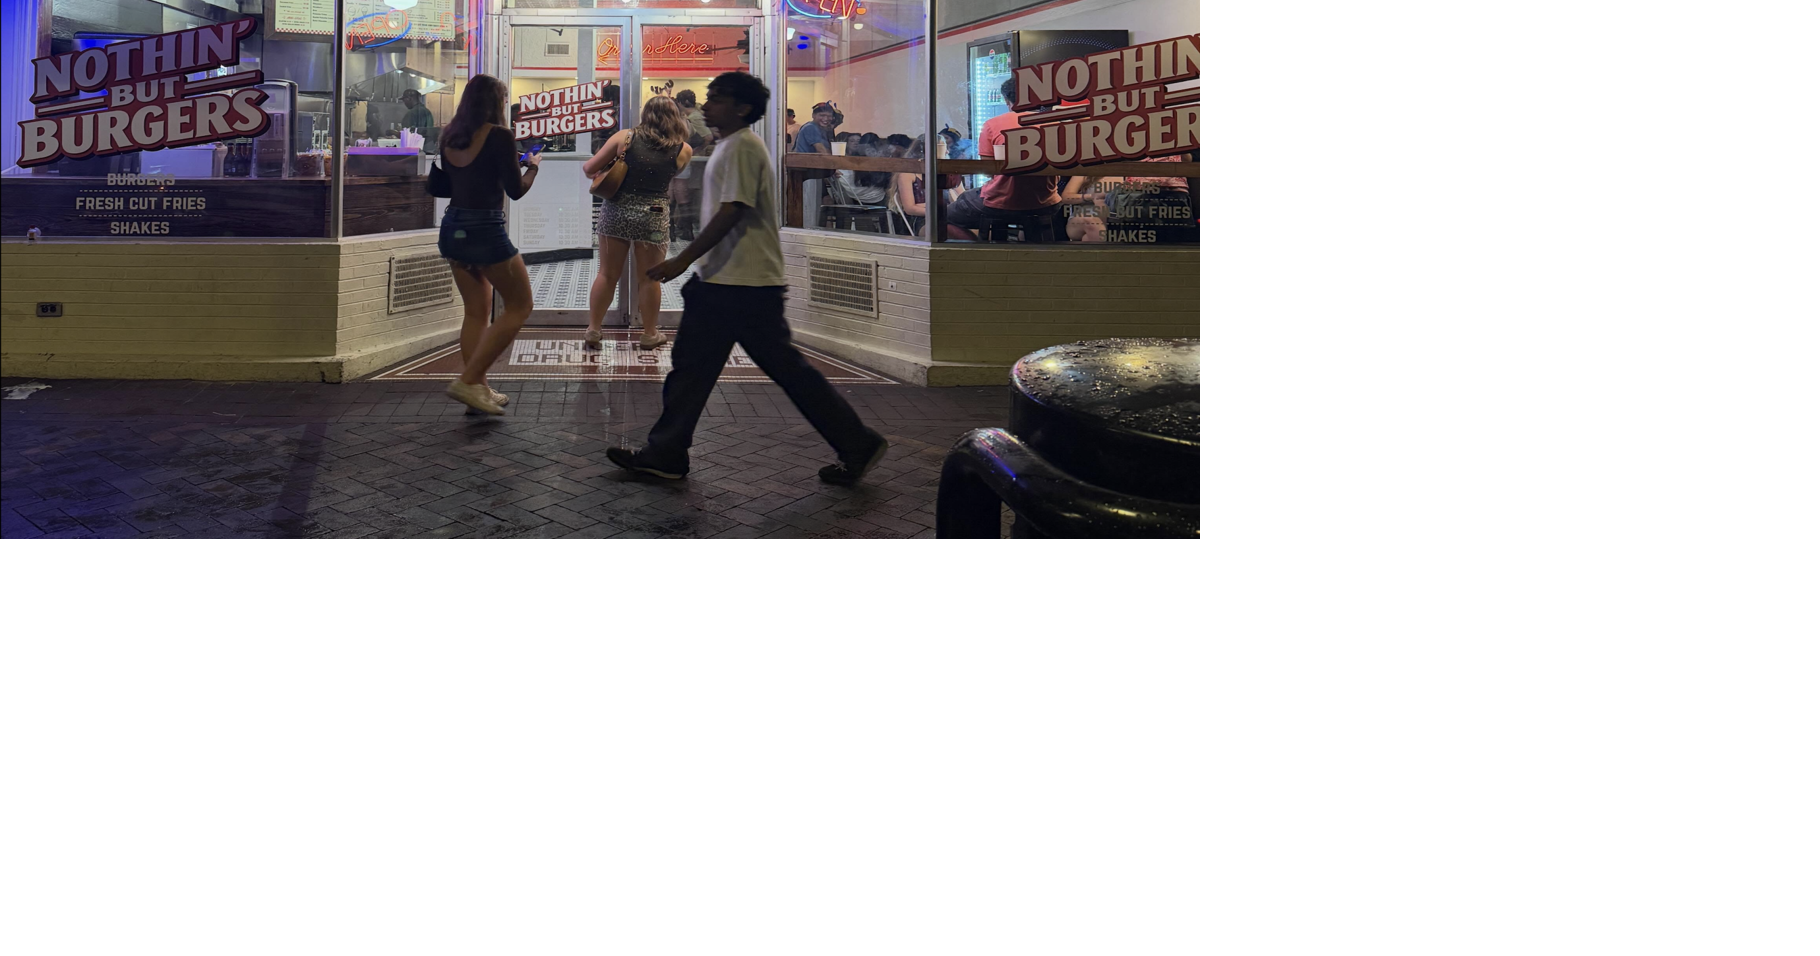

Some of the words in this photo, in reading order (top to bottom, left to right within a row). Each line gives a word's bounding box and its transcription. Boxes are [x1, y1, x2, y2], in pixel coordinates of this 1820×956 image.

[597, 37, 654, 56] Orr
[655, 35, 710, 54] Here
[34, 18, 251, 99] NOTHIN'
[1015, 37, 1200, 107] NOTHIN
[110, 75, 180, 108] BUT
[519, 79, 609, 113] NOTHIN'
[1092, 86, 1160, 117] BUT
[551, 103, 581, 117] BUT
[20, 88, 263, 163] BURGERS
[514, 109, 615, 139] BURGERS
[1004, 105, 1200, 170] BURGER
[107, 173, 176, 186] BURGERS
[1094, 182, 1161, 195] BURGERS
[75, 197, 124, 210] FRESH
[129, 197, 158, 210] CUT
[163, 197, 206, 210] FRIES
[1063, 205, 1111, 218] FRESH
[1116, 206, 1144, 219] CUT
[1149, 206, 1191, 219] FRIES
[110, 221, 170, 234] SHAKES
[1099, 230, 1157, 242] SHAKES
